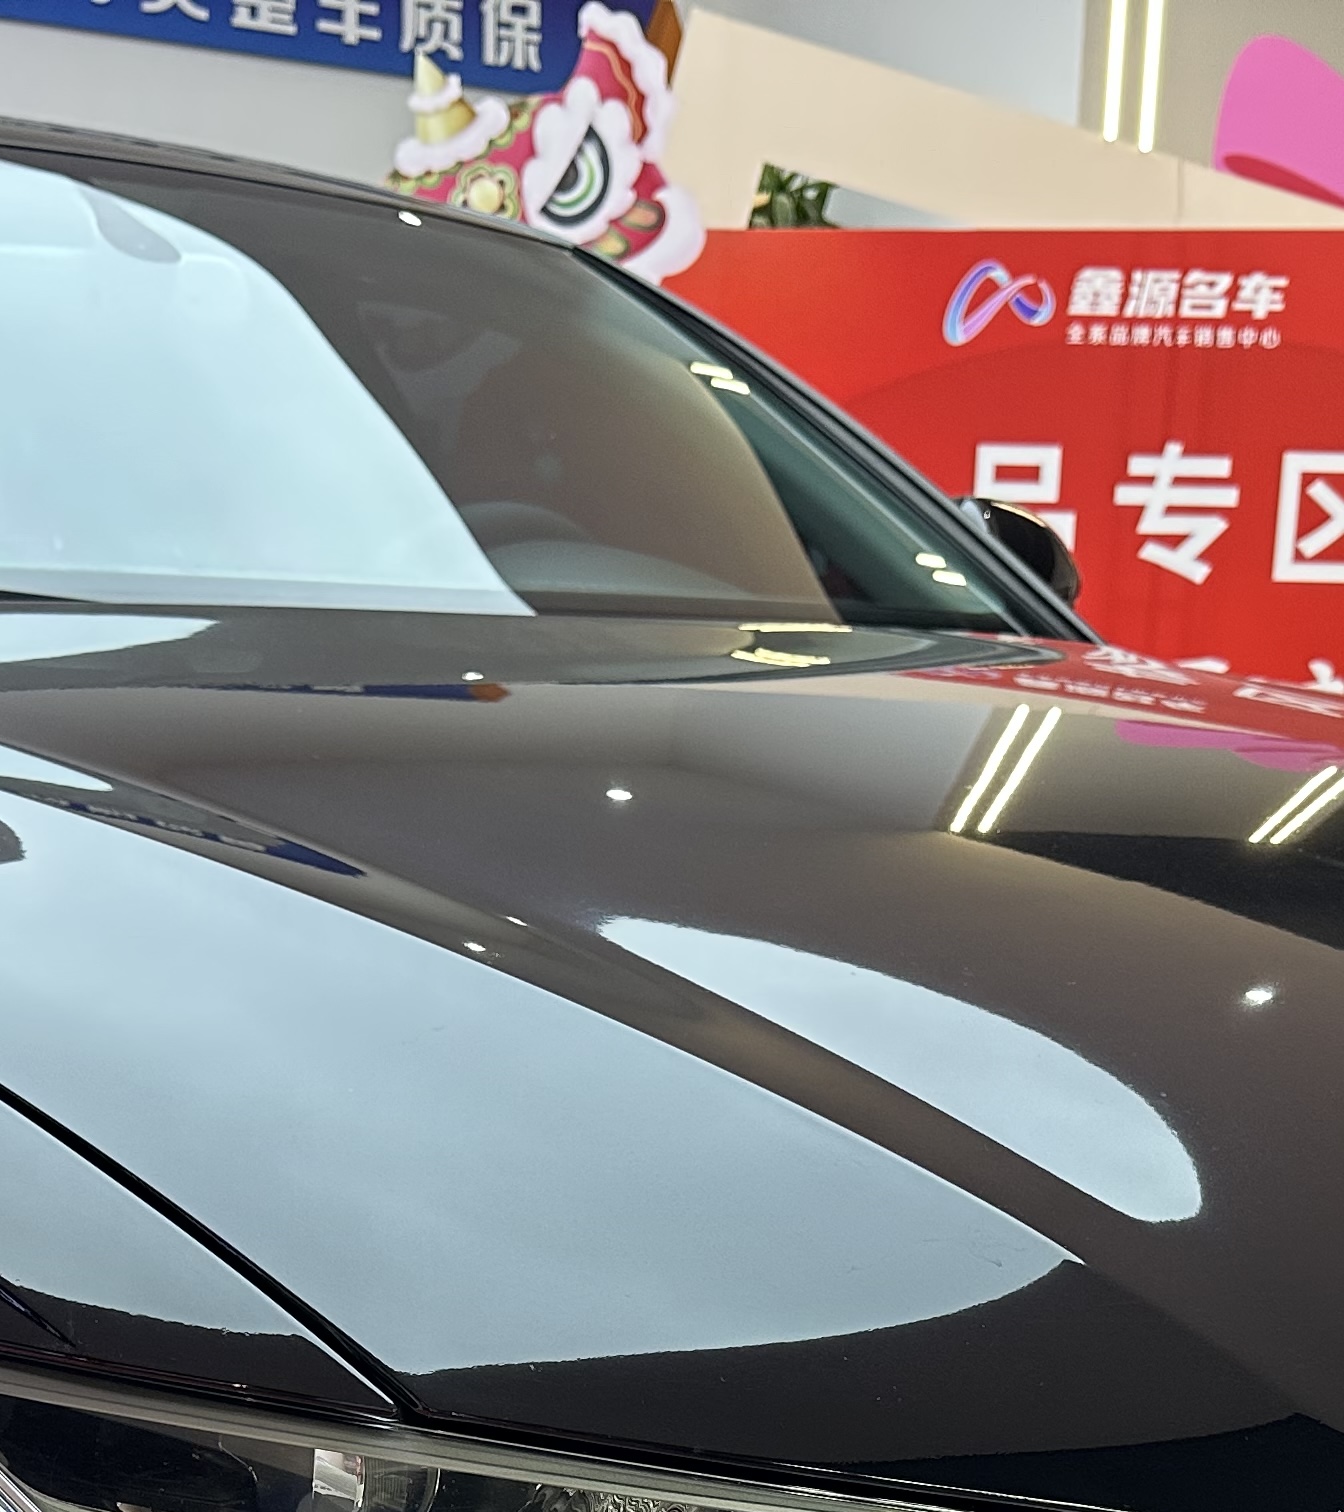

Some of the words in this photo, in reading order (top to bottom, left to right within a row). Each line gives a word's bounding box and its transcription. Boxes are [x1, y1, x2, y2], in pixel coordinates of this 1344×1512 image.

[89, 0, 544, 73] 整车质保
[1066, 265, 1290, 320] 鑫源名车
